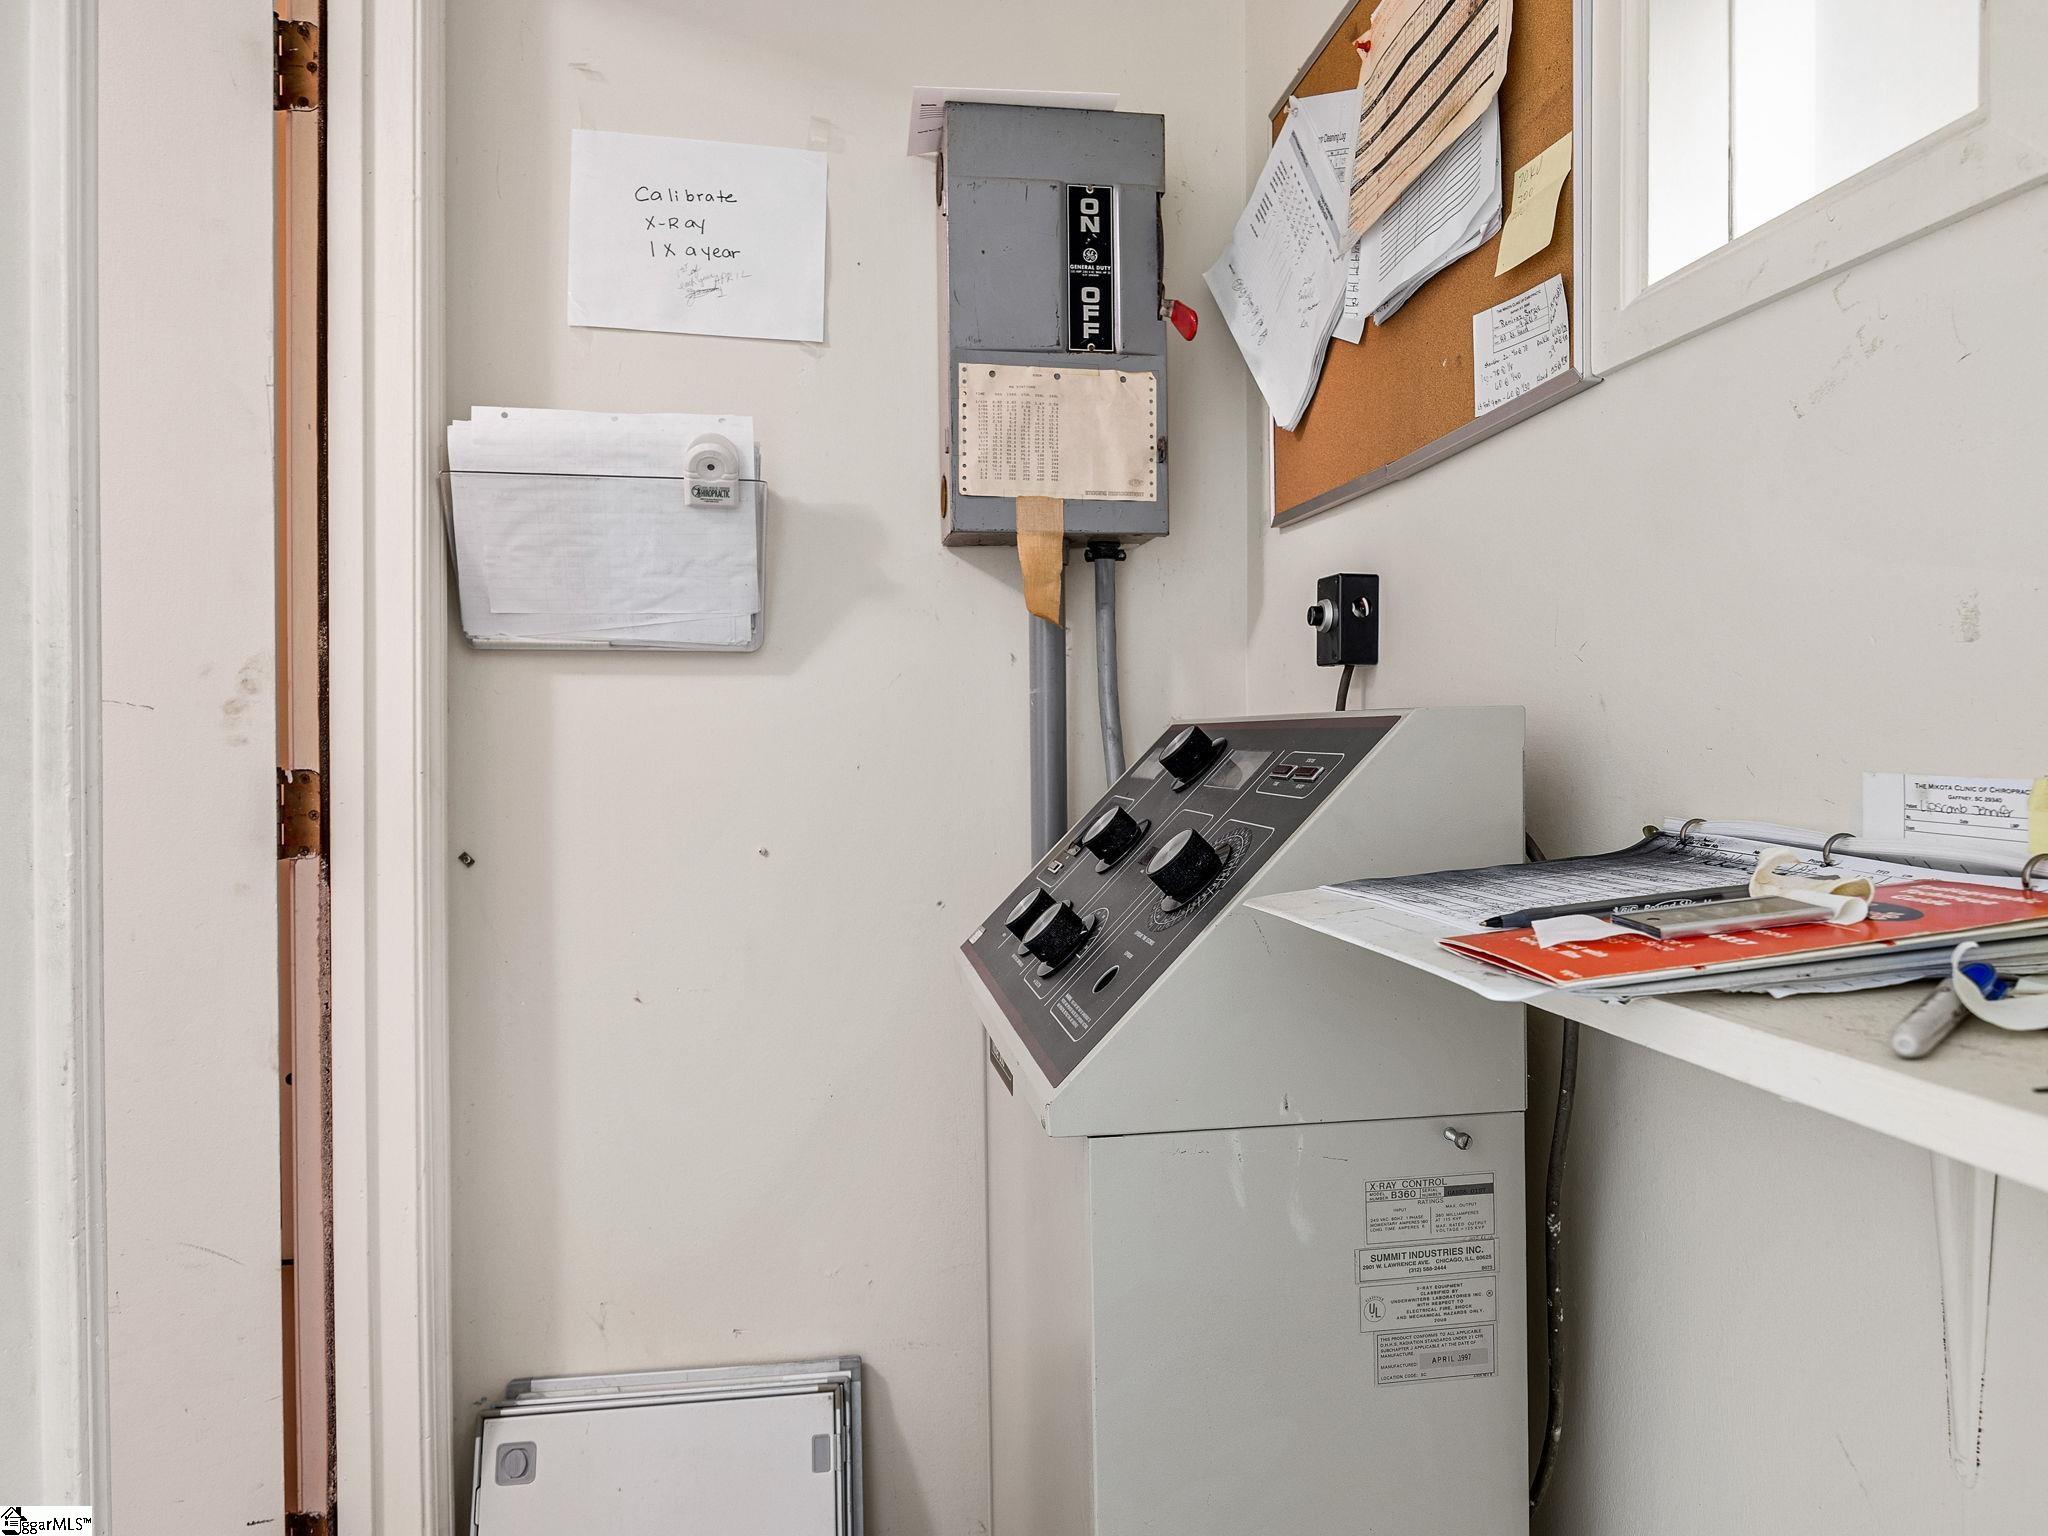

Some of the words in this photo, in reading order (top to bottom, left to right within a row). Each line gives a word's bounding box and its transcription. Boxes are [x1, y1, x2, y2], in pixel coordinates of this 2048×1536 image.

[634, 186, 738, 203] Calibrate
[1080, 198, 1100, 232] ON
[686, 246, 696, 257] a
[701, 246, 740, 260] year
[1081, 286, 1100, 338] OFF
[1990, 786, 2032, 795] CHIROPRAC
[1402, 1178, 1448, 1188] CONTROL
[1391, 1190, 1416, 1199] B360
[1370, 1252, 1407, 1262] SUMMIT
[1408, 1246, 1464, 1259] INDUSTRIES
[1466, 1245, 1484, 1255] INC.
[1432, 1356, 1454, 1364] APRIL
